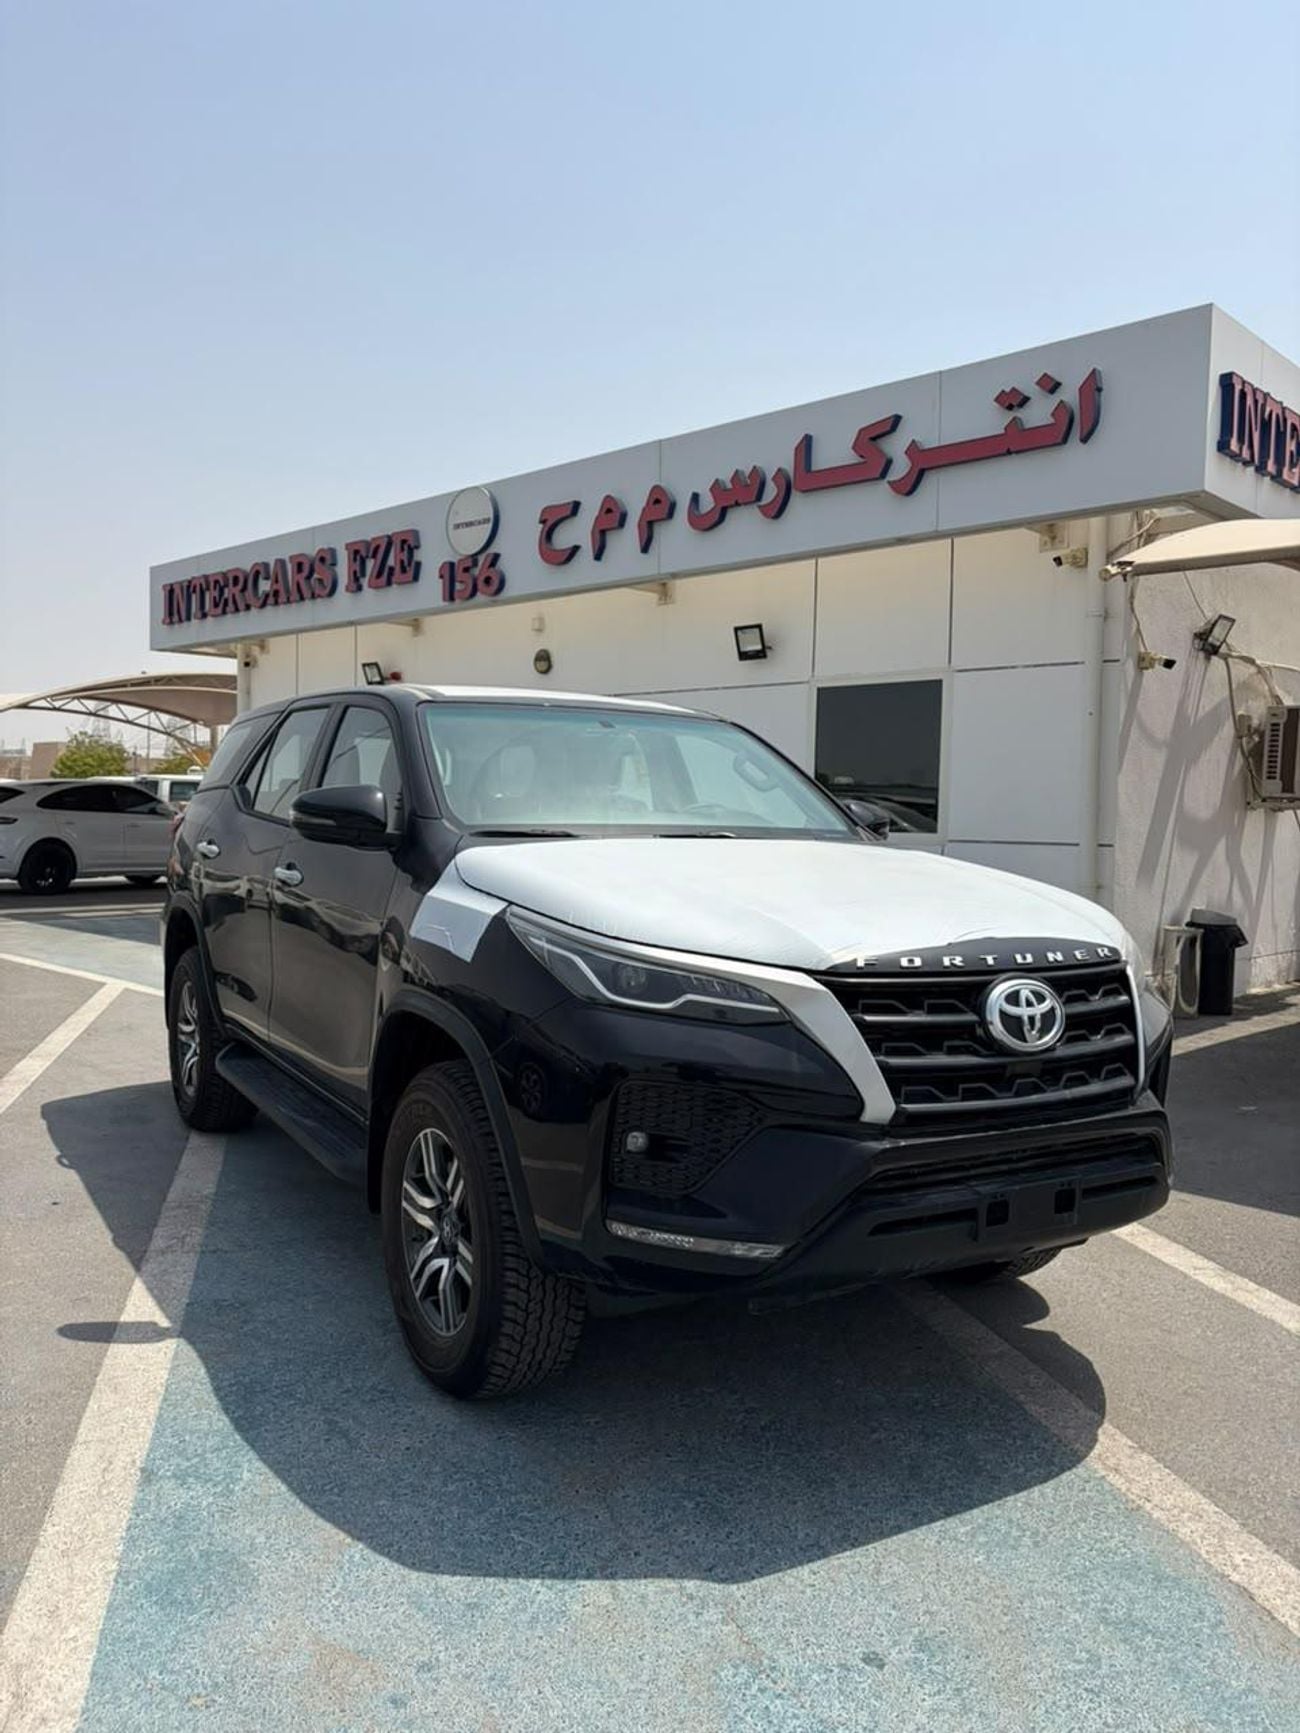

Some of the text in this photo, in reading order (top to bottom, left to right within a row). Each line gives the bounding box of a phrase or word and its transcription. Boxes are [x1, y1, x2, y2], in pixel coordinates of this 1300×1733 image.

[162, 529, 422, 625] INTERCARS FZE
[438, 553, 506, 602] 156
[855, 946, 1113, 969] FORTUNER
